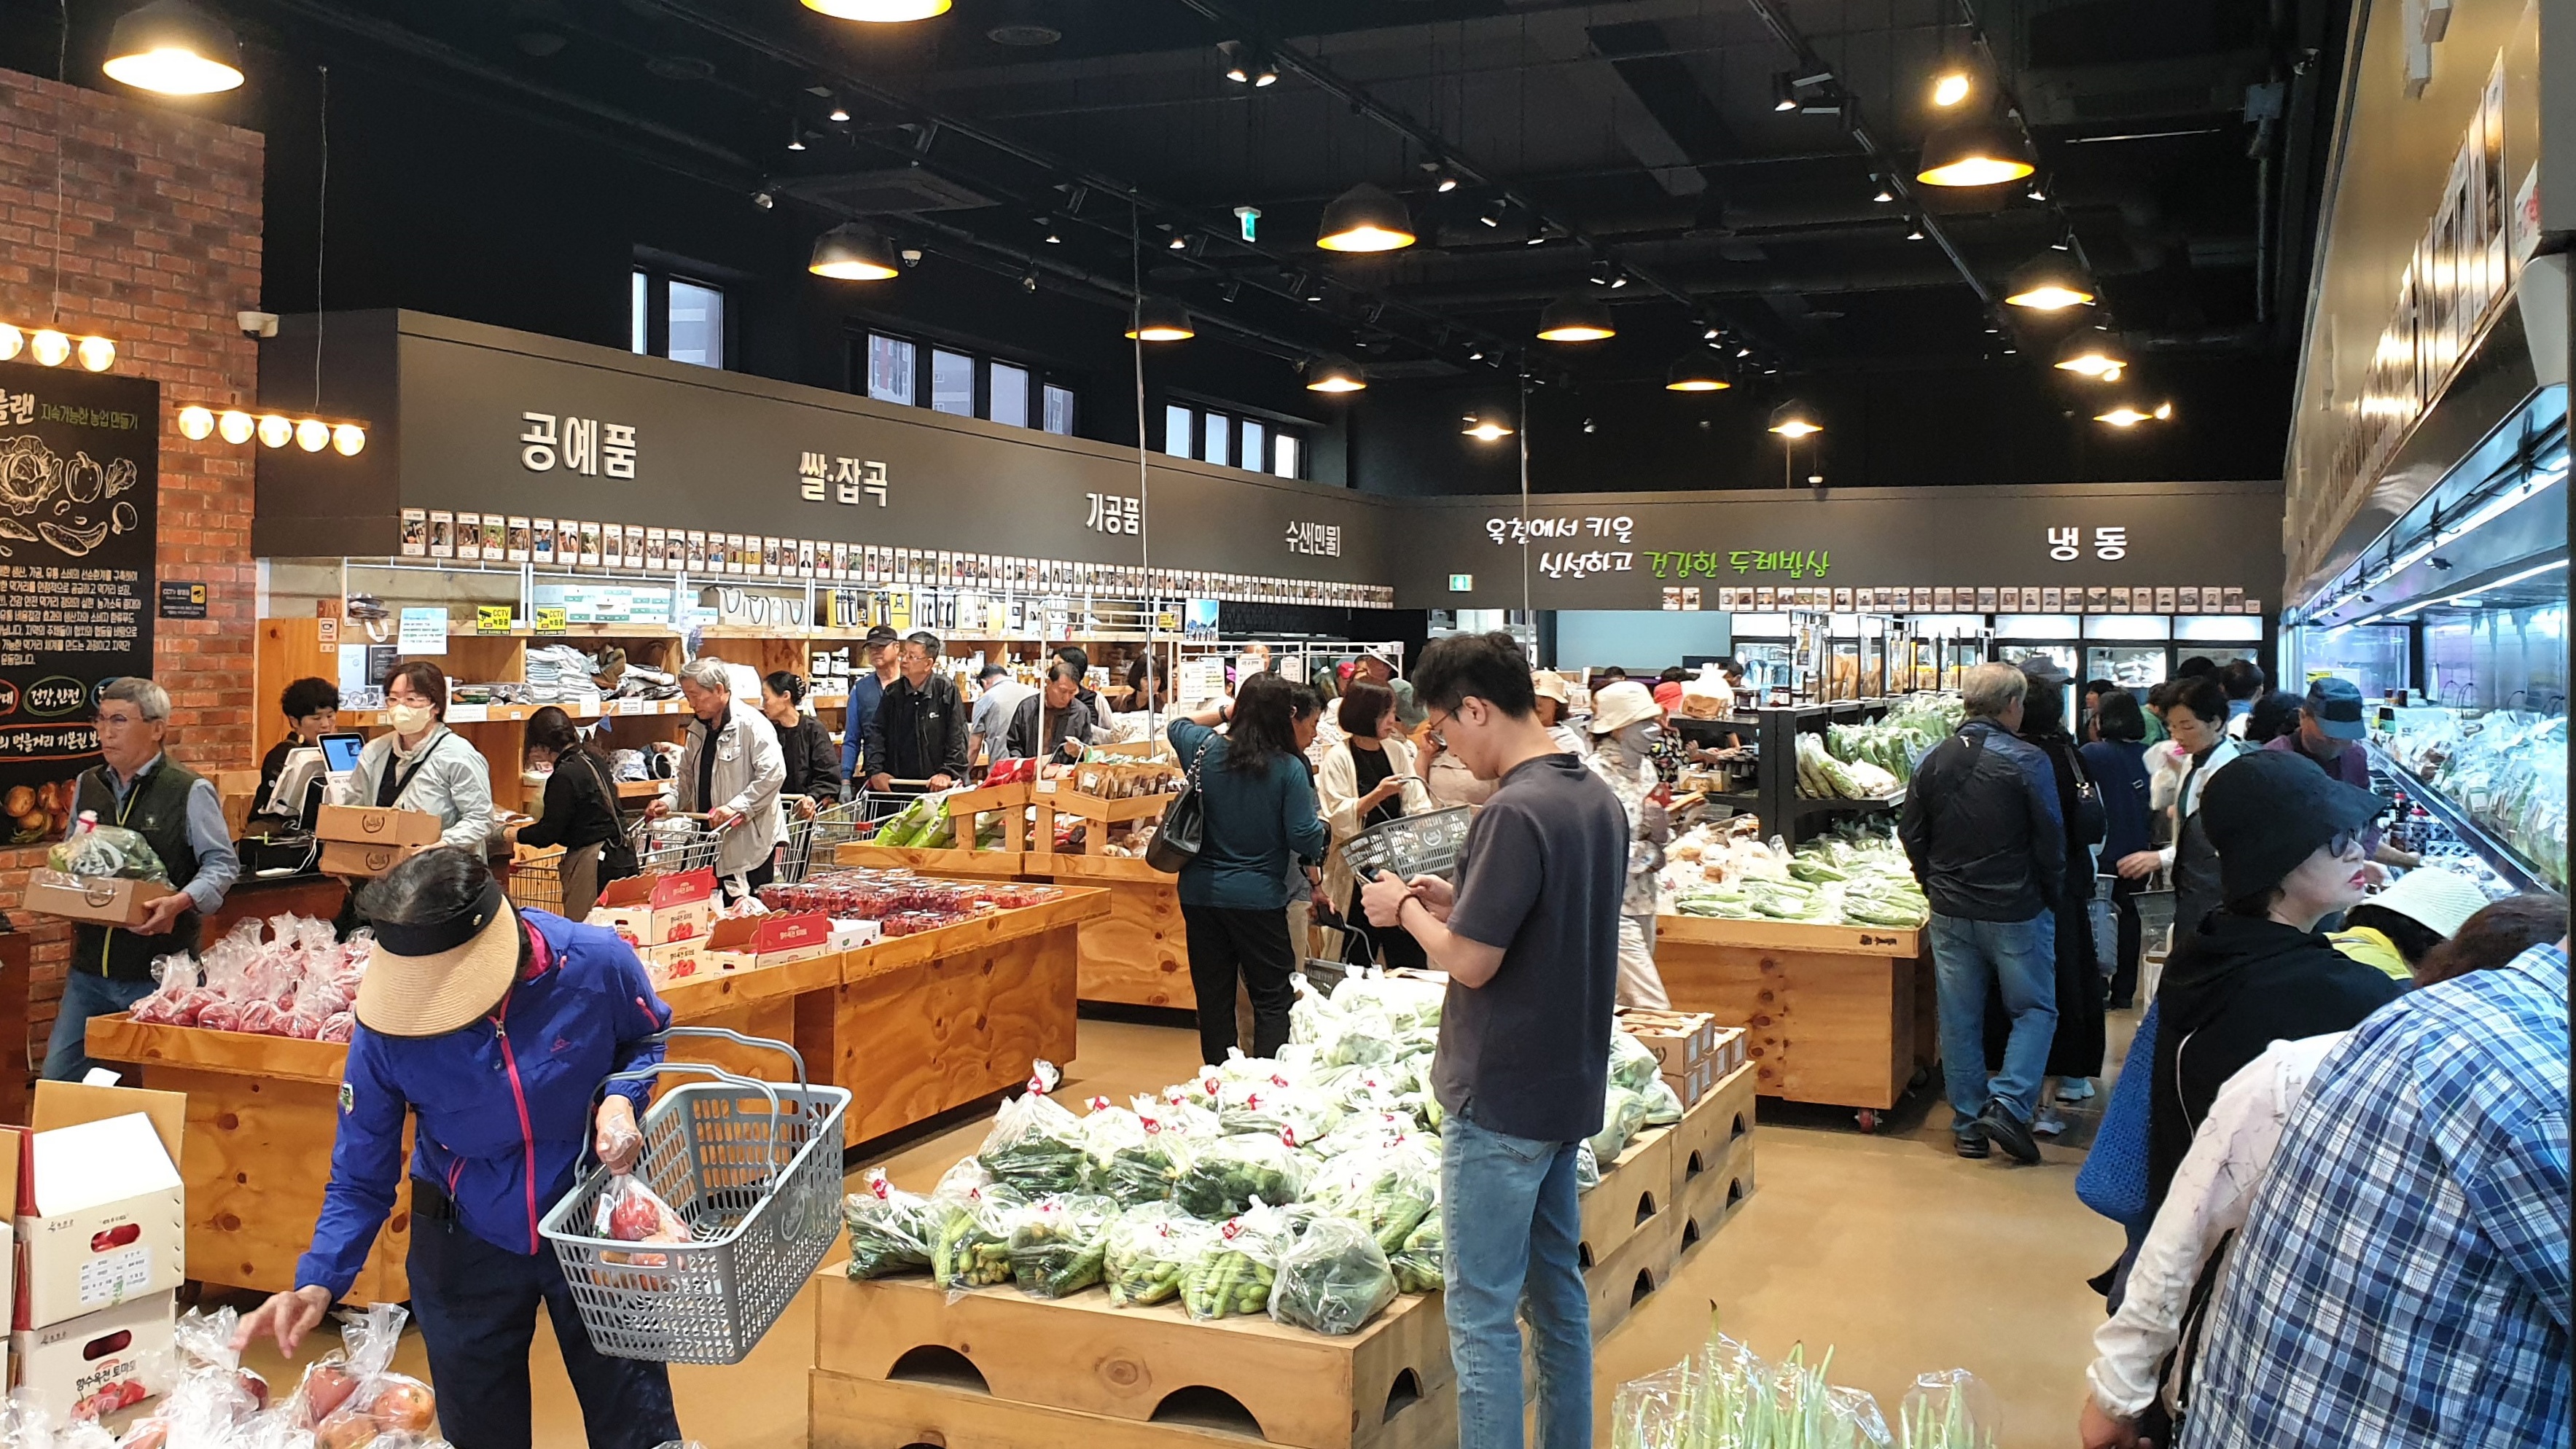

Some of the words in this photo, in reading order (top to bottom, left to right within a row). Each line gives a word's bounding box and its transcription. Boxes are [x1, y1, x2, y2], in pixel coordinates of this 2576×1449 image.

[41, 402, 88, 425] 지속가능한
[90, 408, 109, 428] 농업
[111, 411, 138, 430] 만들기
[520, 411, 637, 480] 공예품
[1085, 493, 1140, 535] 가공품
[1486, 517, 1579, 545] 옥천에서
[1539, 550, 1634, 579] 신선하고
[1643, 550, 1718, 578] 건강한
[1728, 550, 1831, 579] 두레밥상
[493, 609, 509, 617] CCTV
[549, 610, 564, 618] CCTV
[31, 687, 80, 708] 건강,안전
[12, 732, 55, 753] 먹을거리
[57, 730, 87, 751] 기본권
[89, 730, 101, 748] 보
